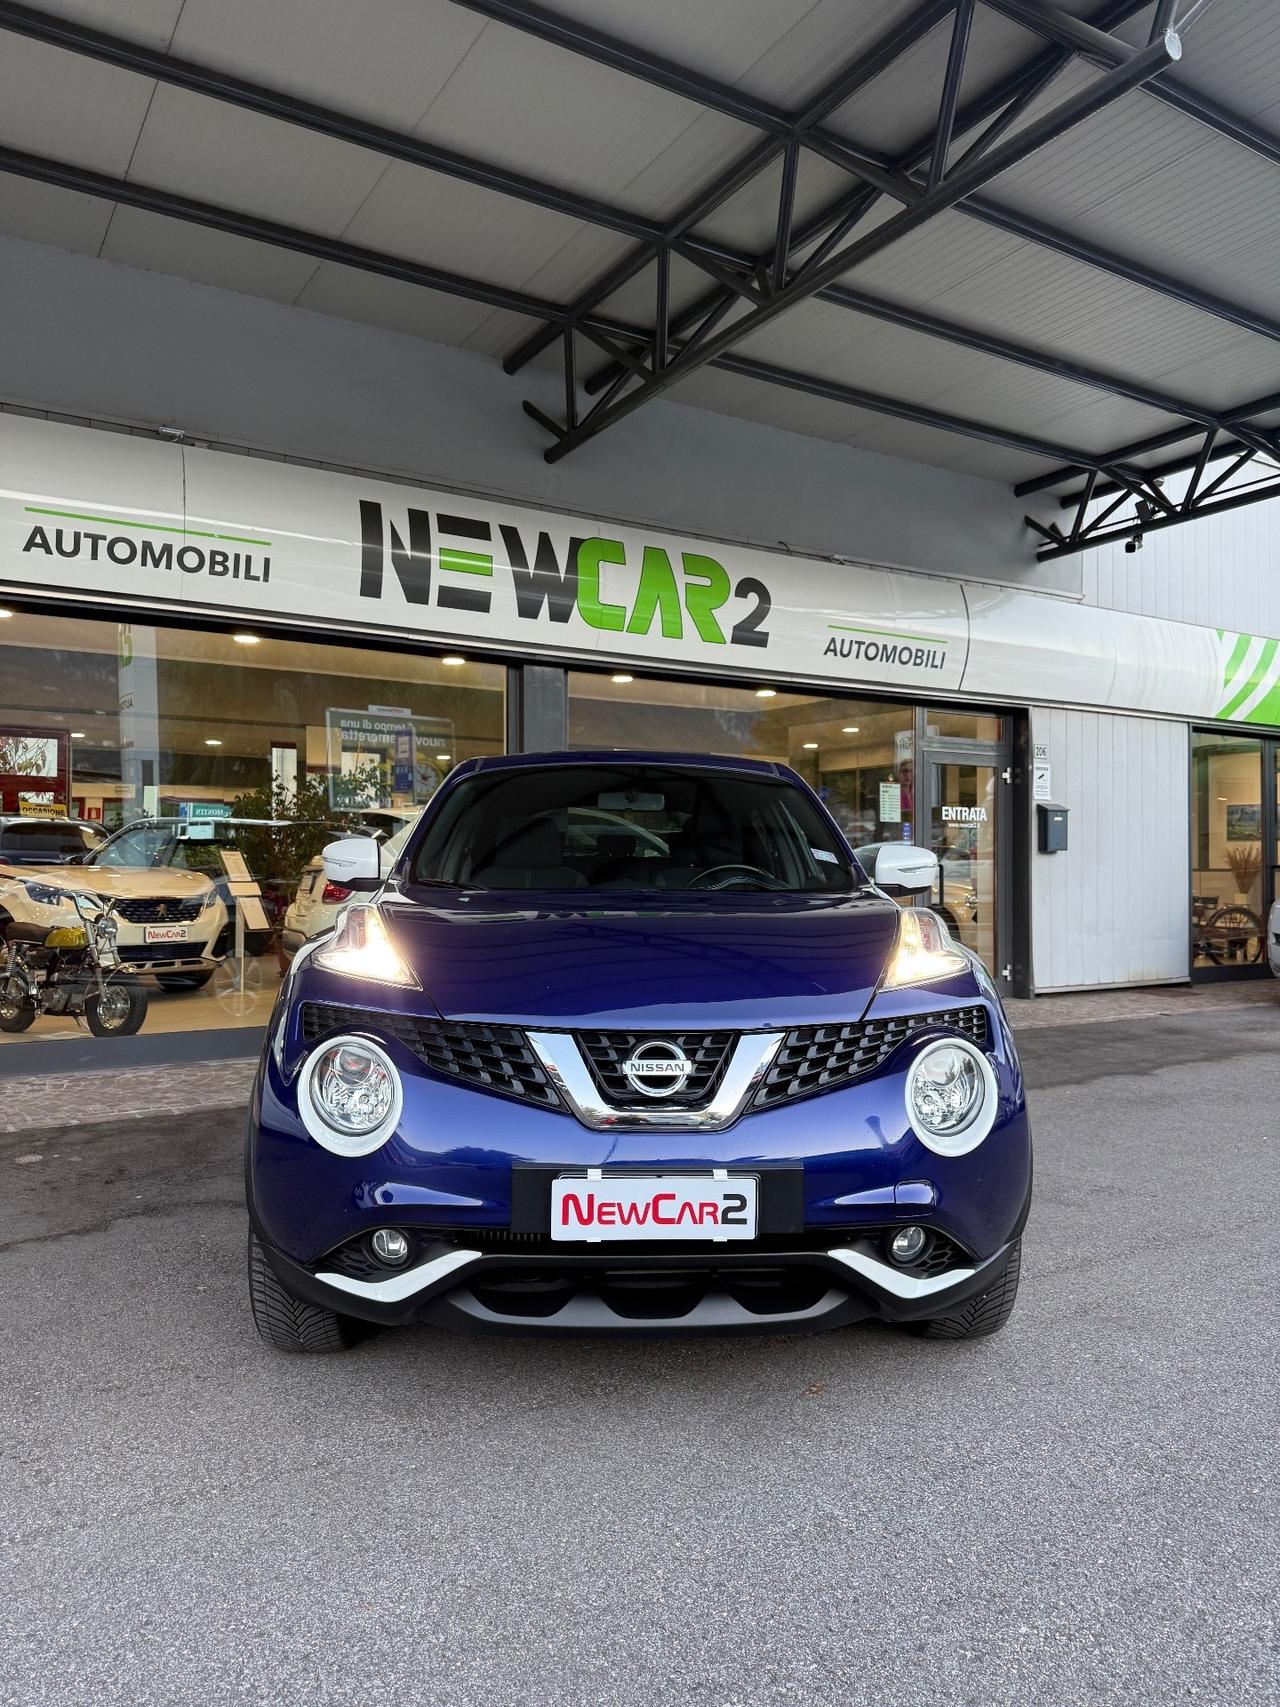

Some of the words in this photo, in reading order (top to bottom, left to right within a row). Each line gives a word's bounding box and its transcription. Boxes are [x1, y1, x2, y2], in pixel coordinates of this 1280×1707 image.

[22, 525, 271, 583] AUTOMOBILI
[824, 636, 945, 670] AUTOMOBILI
[1036, 746, 1047, 756] 206
[22, 807, 65, 816] OCCASIONE
[942, 806, 987, 821] ENTRATA
[630, 1062, 685, 1072] NISSAN
